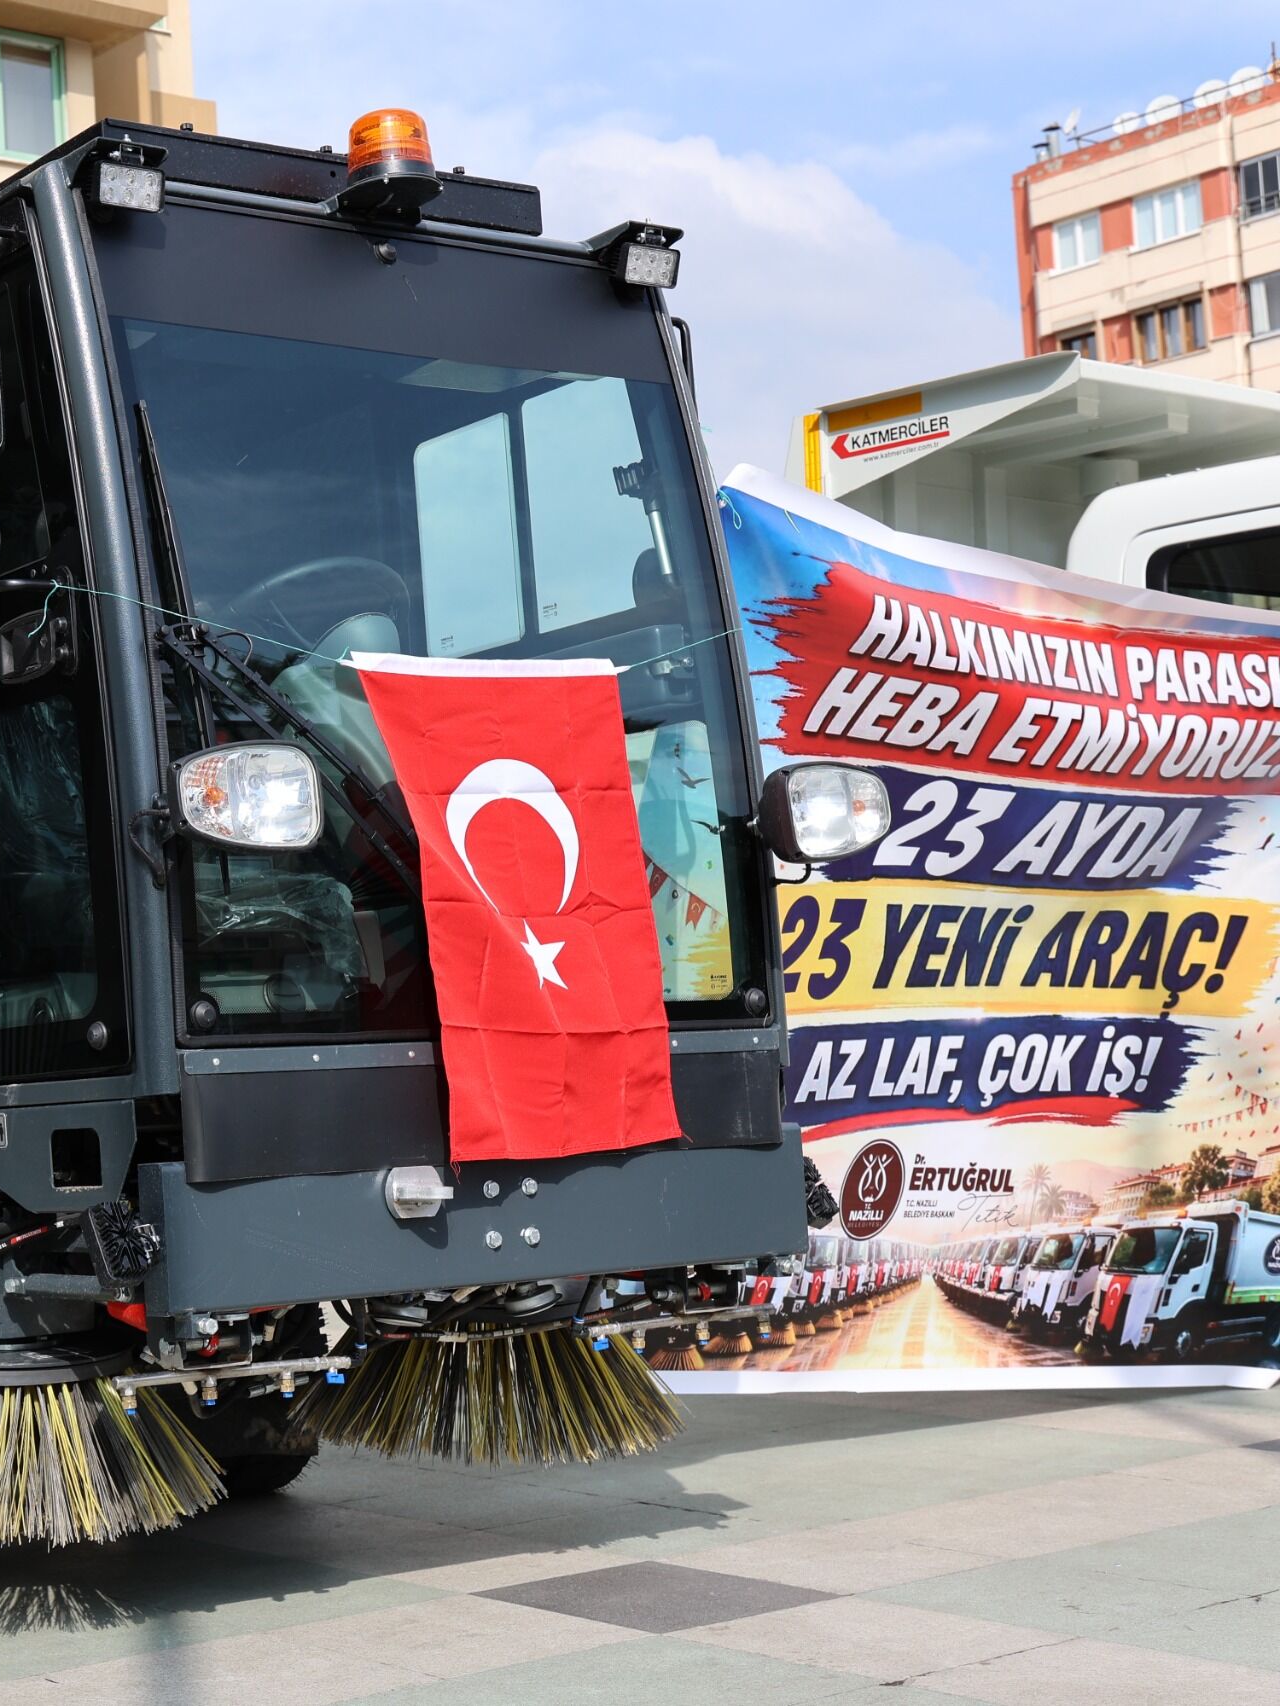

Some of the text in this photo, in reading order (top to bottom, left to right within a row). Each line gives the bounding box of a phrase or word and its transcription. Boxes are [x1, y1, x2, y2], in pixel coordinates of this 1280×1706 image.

[851, 415, 950, 450] KATMERCİLER
[849, 594, 1119, 697] HALKIMIZIN
[802, 667, 999, 756] HEBA
[873, 780, 1203, 879] 23 AYDA
[782, 895, 1248, 1009] 23 YENİ ARAÇ!
[794, 1025, 1164, 1108] AZ LAF, ÇOK İŞ!
[908, 1162, 1014, 1193] ERTUĞRUL
[914, 1153, 926, 1165] Dr.
[848, 1209, 885, 1222] NAZİLLİ
[930, 1209, 955, 1219] BAŞKANI
